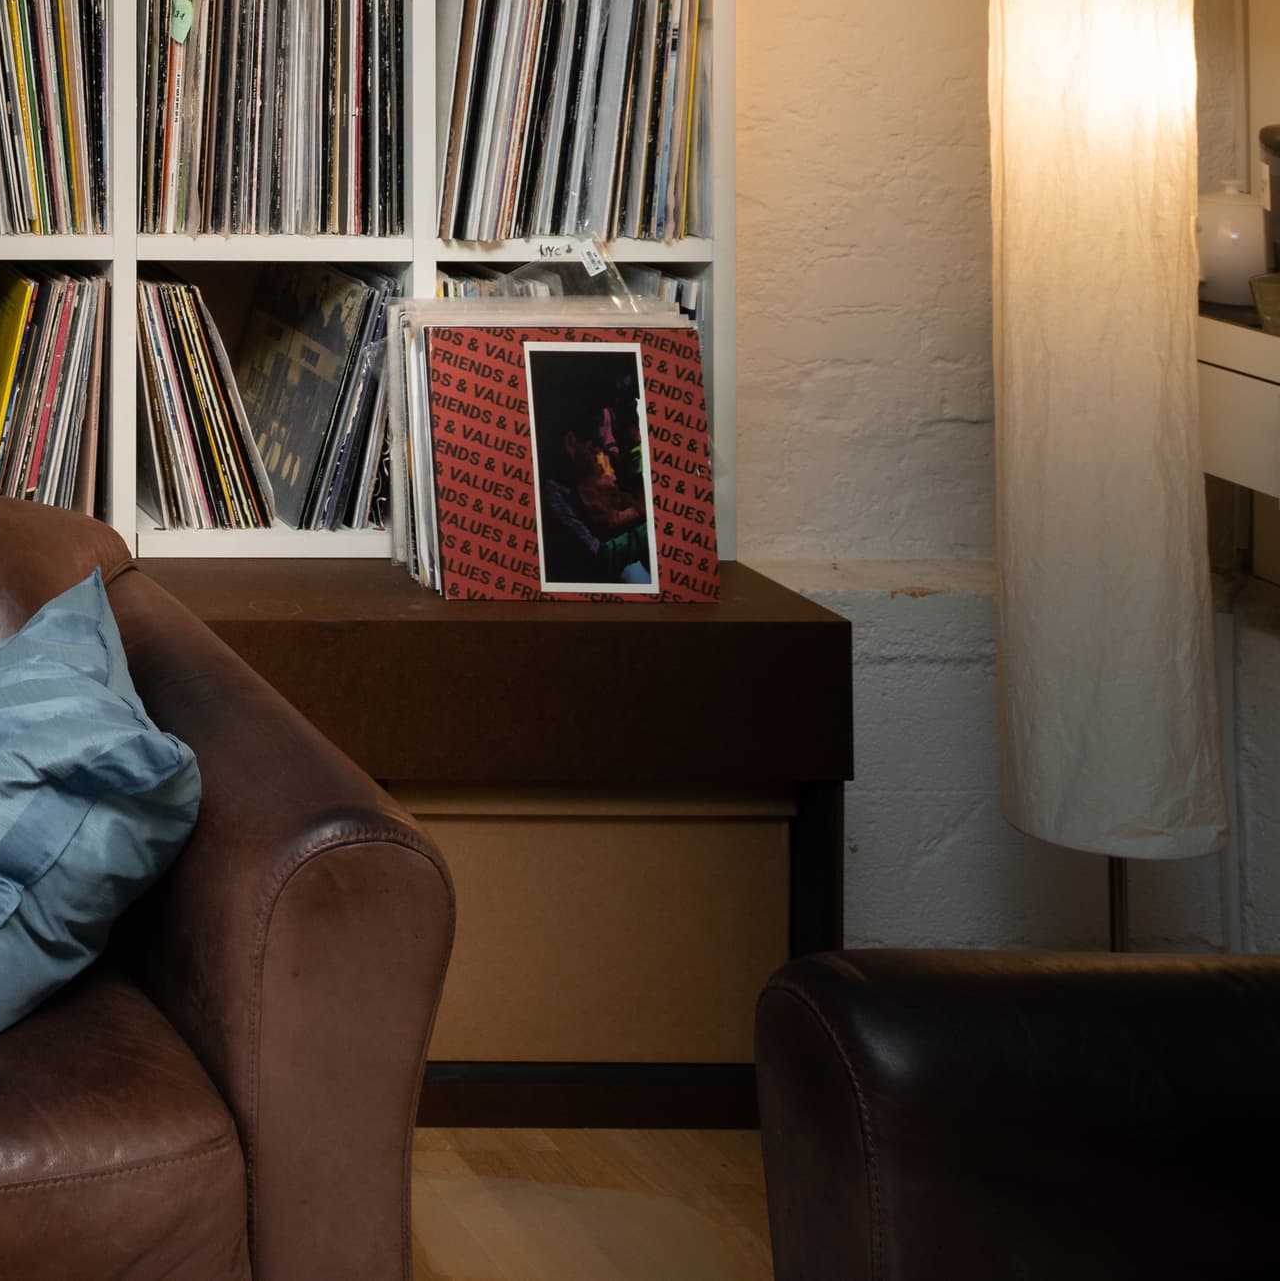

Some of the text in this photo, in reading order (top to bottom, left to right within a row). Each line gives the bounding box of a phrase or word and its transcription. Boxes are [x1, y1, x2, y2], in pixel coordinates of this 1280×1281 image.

[432, 347, 504, 383] FRIENDS
[463, 425, 527, 459] VALUES
[450, 466, 514, 501] VALUES
[478, 545, 540, 581] VALUES
